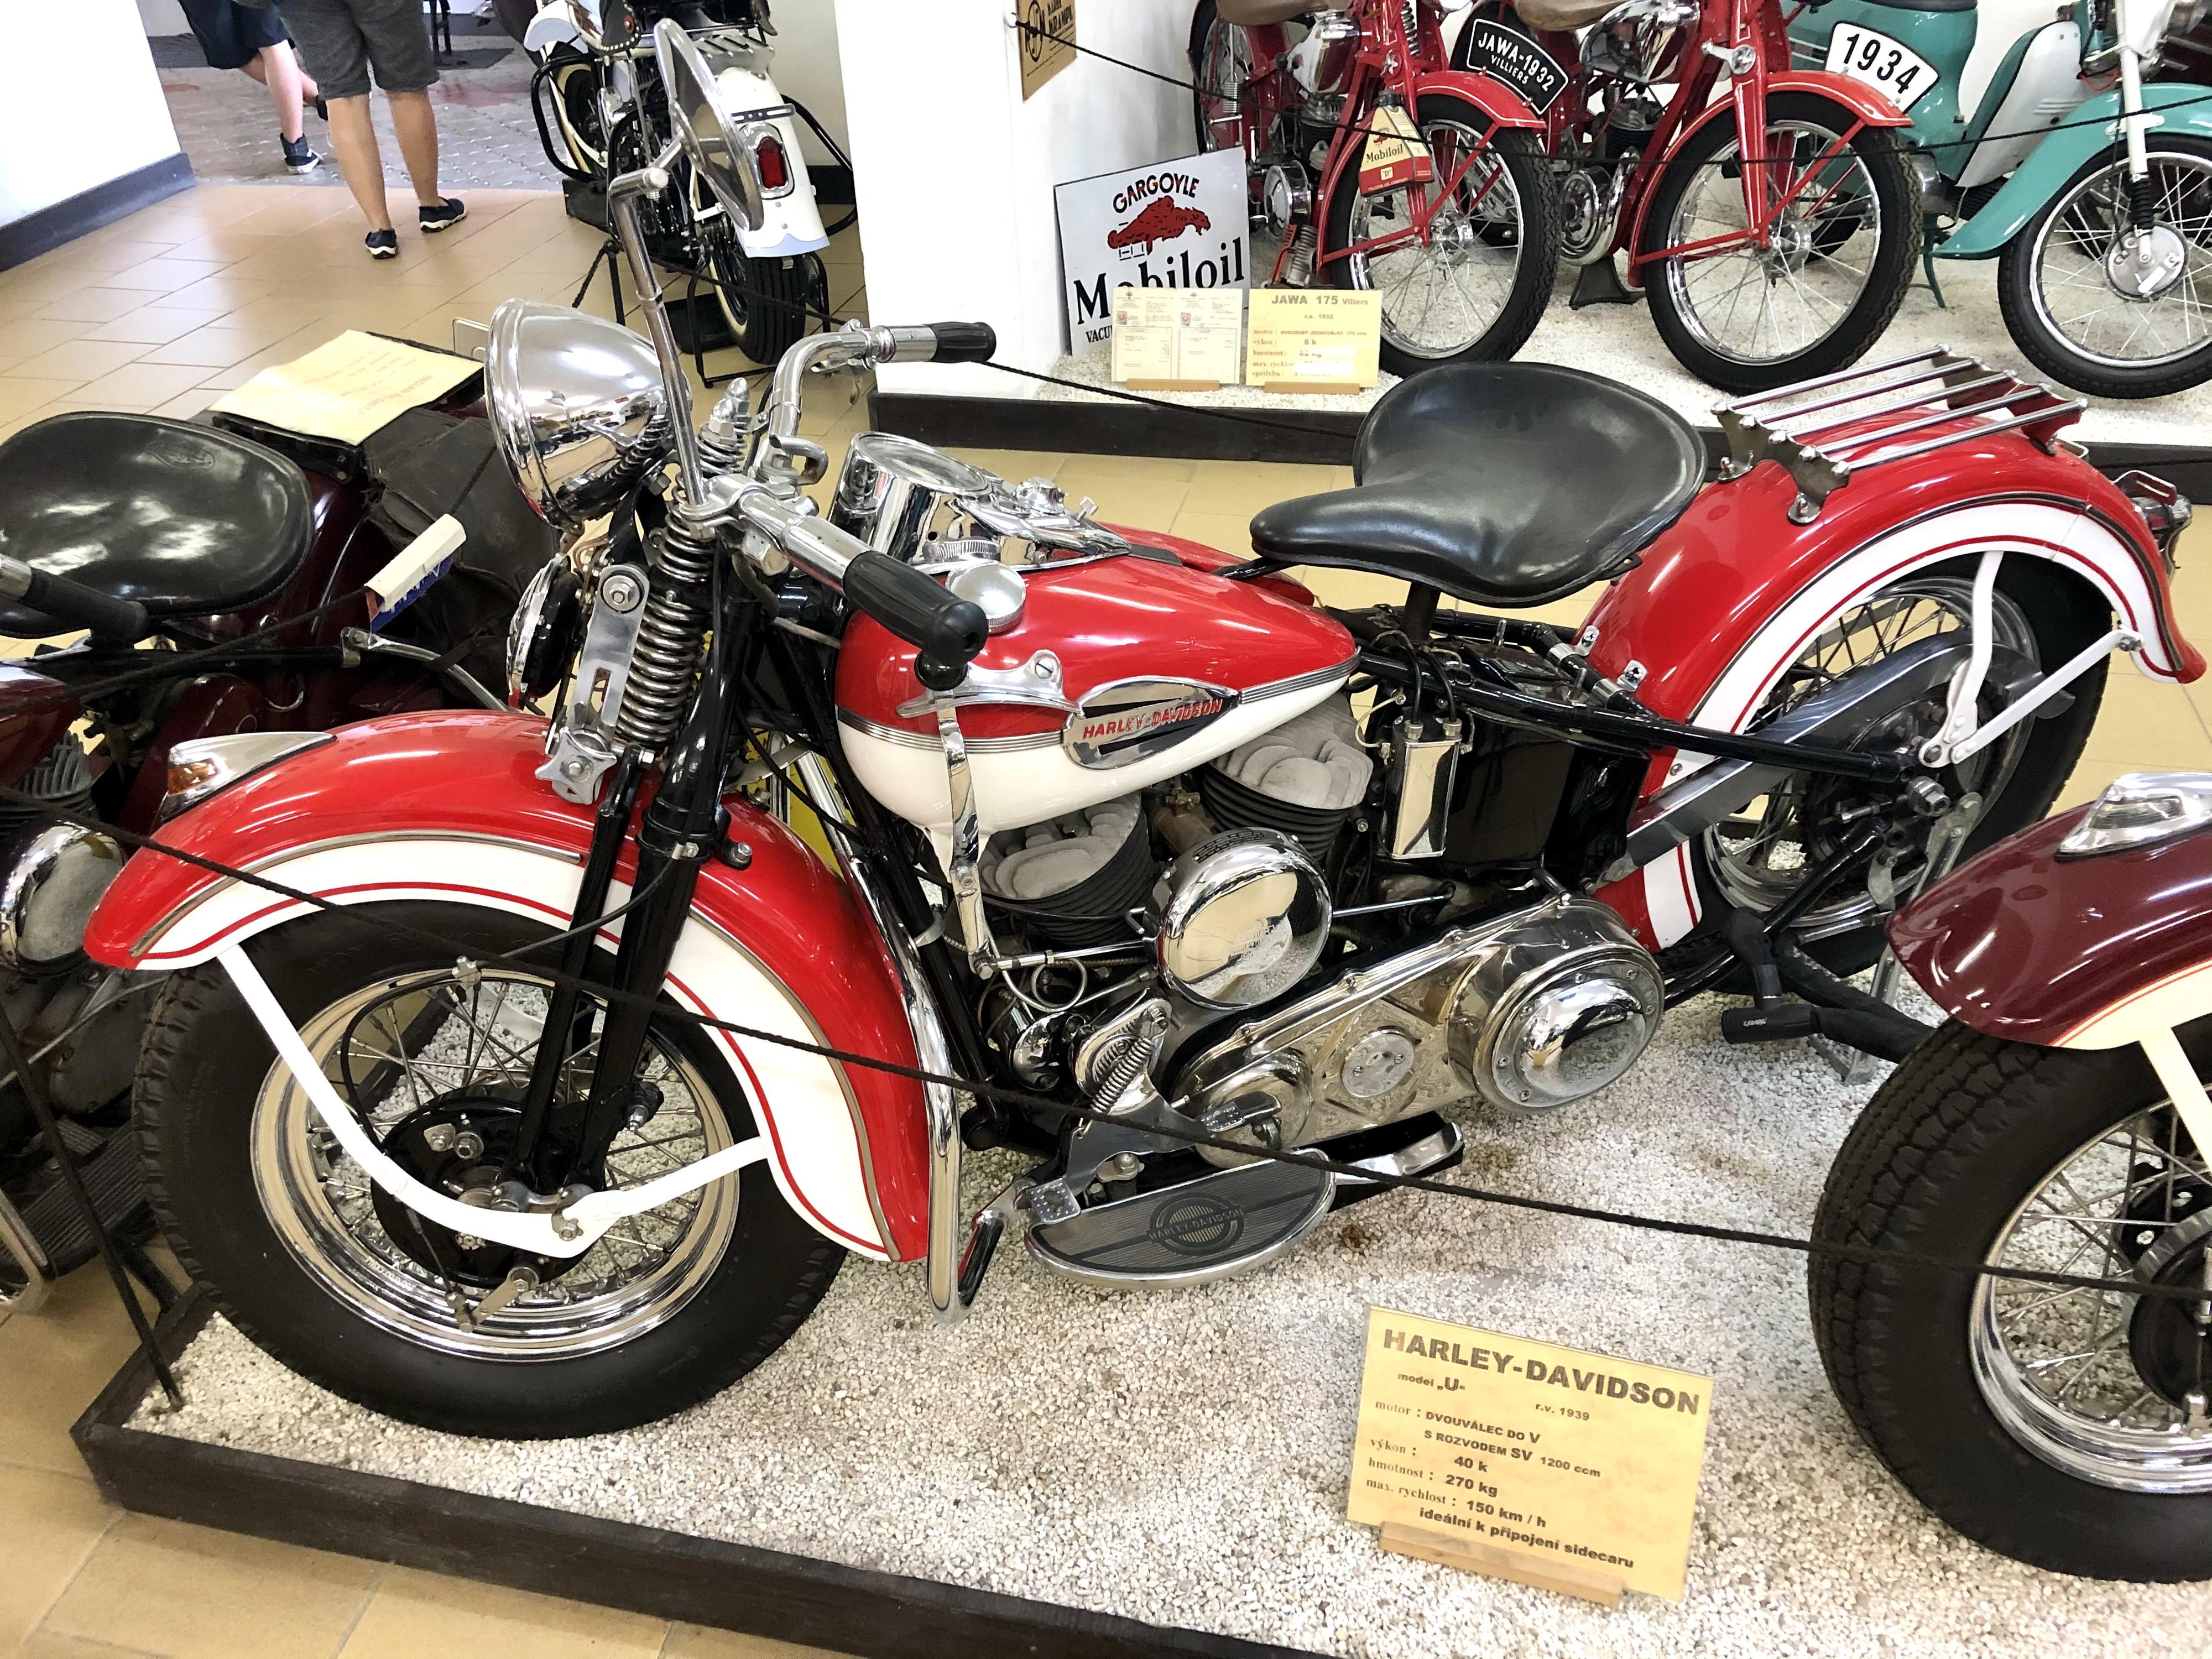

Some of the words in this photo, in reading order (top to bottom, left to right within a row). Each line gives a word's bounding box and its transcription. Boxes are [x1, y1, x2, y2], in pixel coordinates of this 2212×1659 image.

[1478, 32, 1554, 92] JAWA-1932
[1491, 55, 1528, 84] VILLIERS
[1844, 33, 1920, 94] 1934
[1366, 144, 1404, 162] Mobiloil
[1113, 173, 1199, 213] GARGOYLE
[1074, 237, 1244, 324] Mbiloil
[1271, 295, 1307, 304] JAWA
[1316, 295, 1338, 304] 175
[1083, 699, 1223, 739] HARLEY-DAVIDSON
[1384, 1328, 1699, 1415] HARLEY-DAVIDSON
[1397, 1373, 1434, 1386] model
[1375, 1401, 1411, 1415] motor
[1426, 1411, 1503, 1436] DVOUVÁLEC
[1507, 1429, 1525, 1441] DO
[1529, 1432, 1541, 1444] V
[1536, 1403, 1554, 1413] r.v.
[1560, 1407, 1590, 1421] 1939
[1370, 1439, 1406, 1454] výkon
[1454, 1456, 1473, 1469] 40
[1478, 1460, 1488, 1473] k
[1424, 1430, 1432, 1439] S
[1436, 1432, 1507, 1455] ROZVODEM
[1510, 1447, 1533, 1461] SV
[1541, 1456, 1571, 1470] 1200
[1574, 1465, 1601, 1477] ccm
[1369, 1457, 1424, 1479] hmotnost
[1445, 1474, 1474, 1490] 270
[1479, 1481, 1498, 1498] kg
[1366, 1479, 1394, 1492] max.
[1399, 1486, 1446, 1504] rychlost
[1467, 1500, 1494, 1515] 150
[1499, 1507, 1522, 1522] km
[1537, 1516, 1546, 1528] h
[1420, 1507, 1472, 1528] ideální
[1475, 1520, 1485, 1532] k
[1490, 1526, 1561, 1551] připojení
[1564, 1543, 1634, 1568] sidecaru
